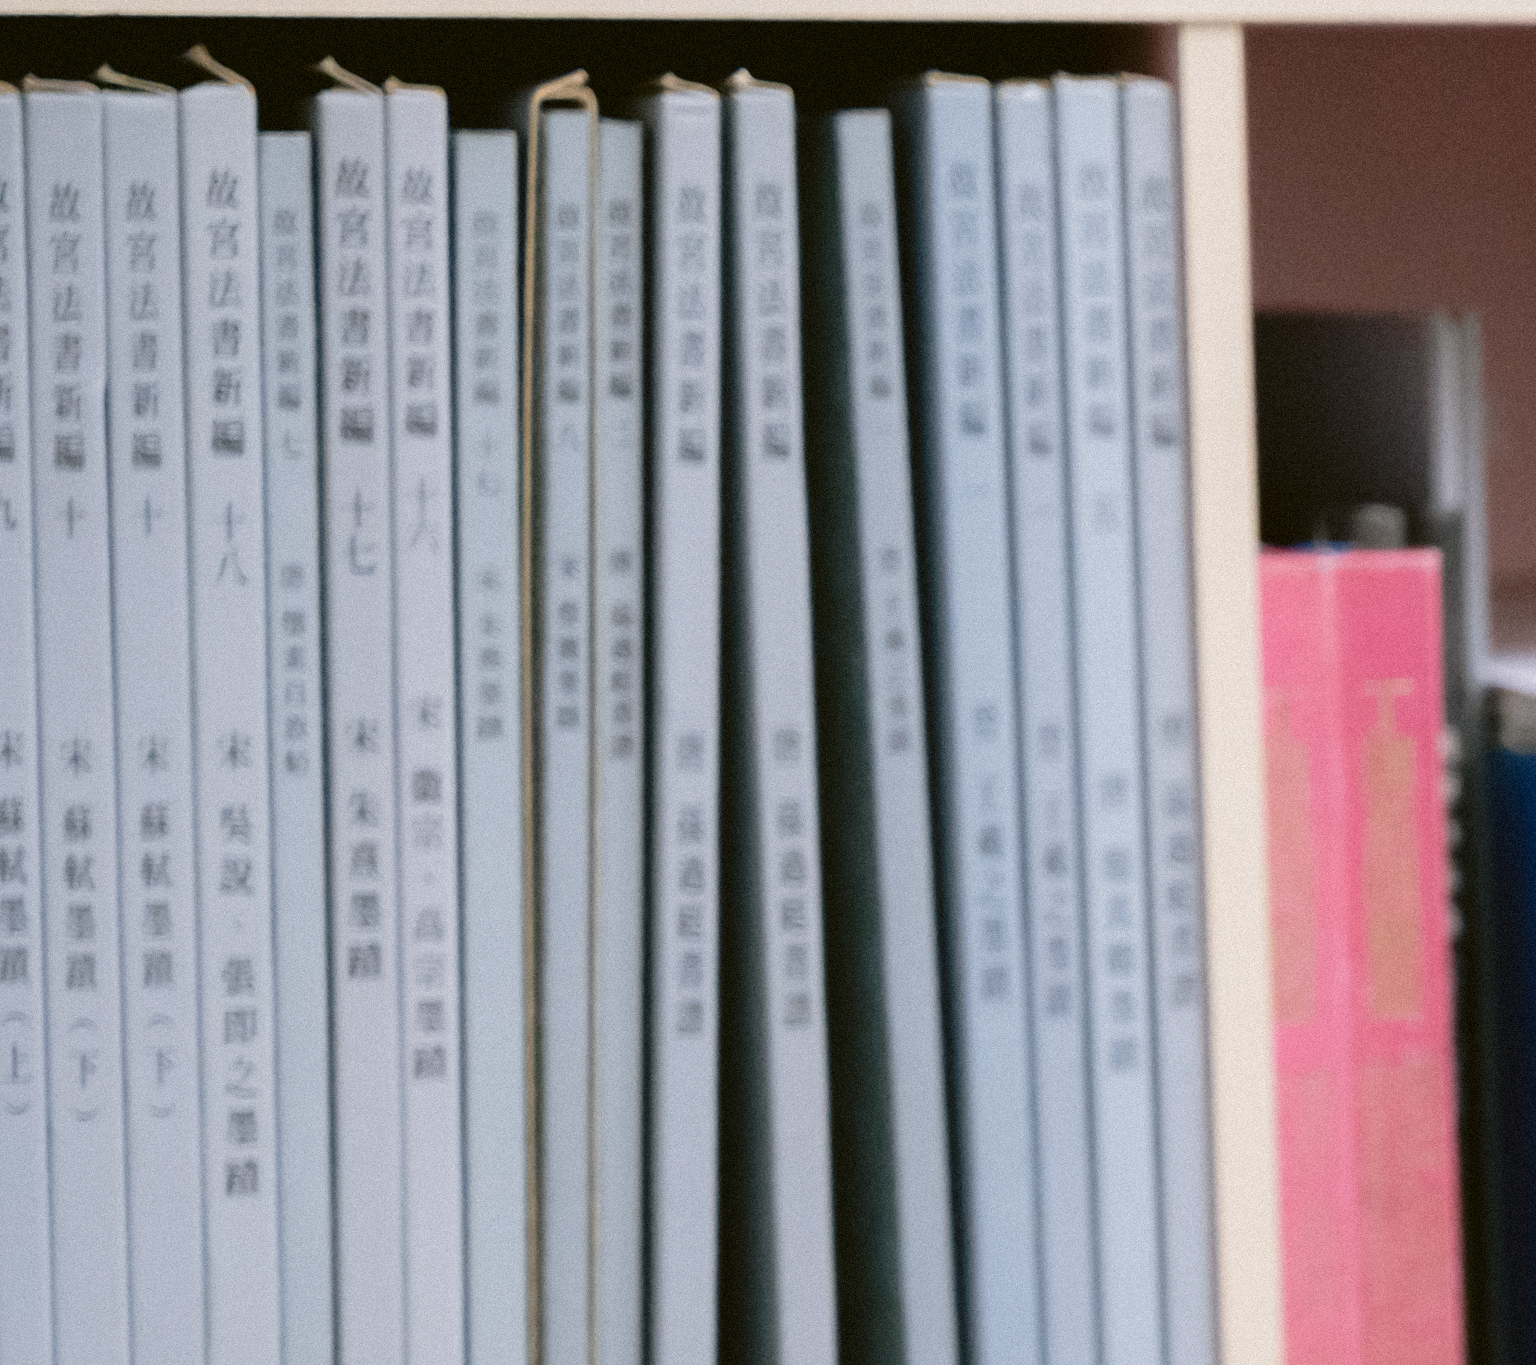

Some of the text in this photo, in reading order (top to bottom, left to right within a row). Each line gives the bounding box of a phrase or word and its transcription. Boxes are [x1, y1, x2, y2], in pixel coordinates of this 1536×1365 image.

[206, 166, 246, 456] 故宮法書新編
[335, 157, 376, 444] 故宮法書新編
